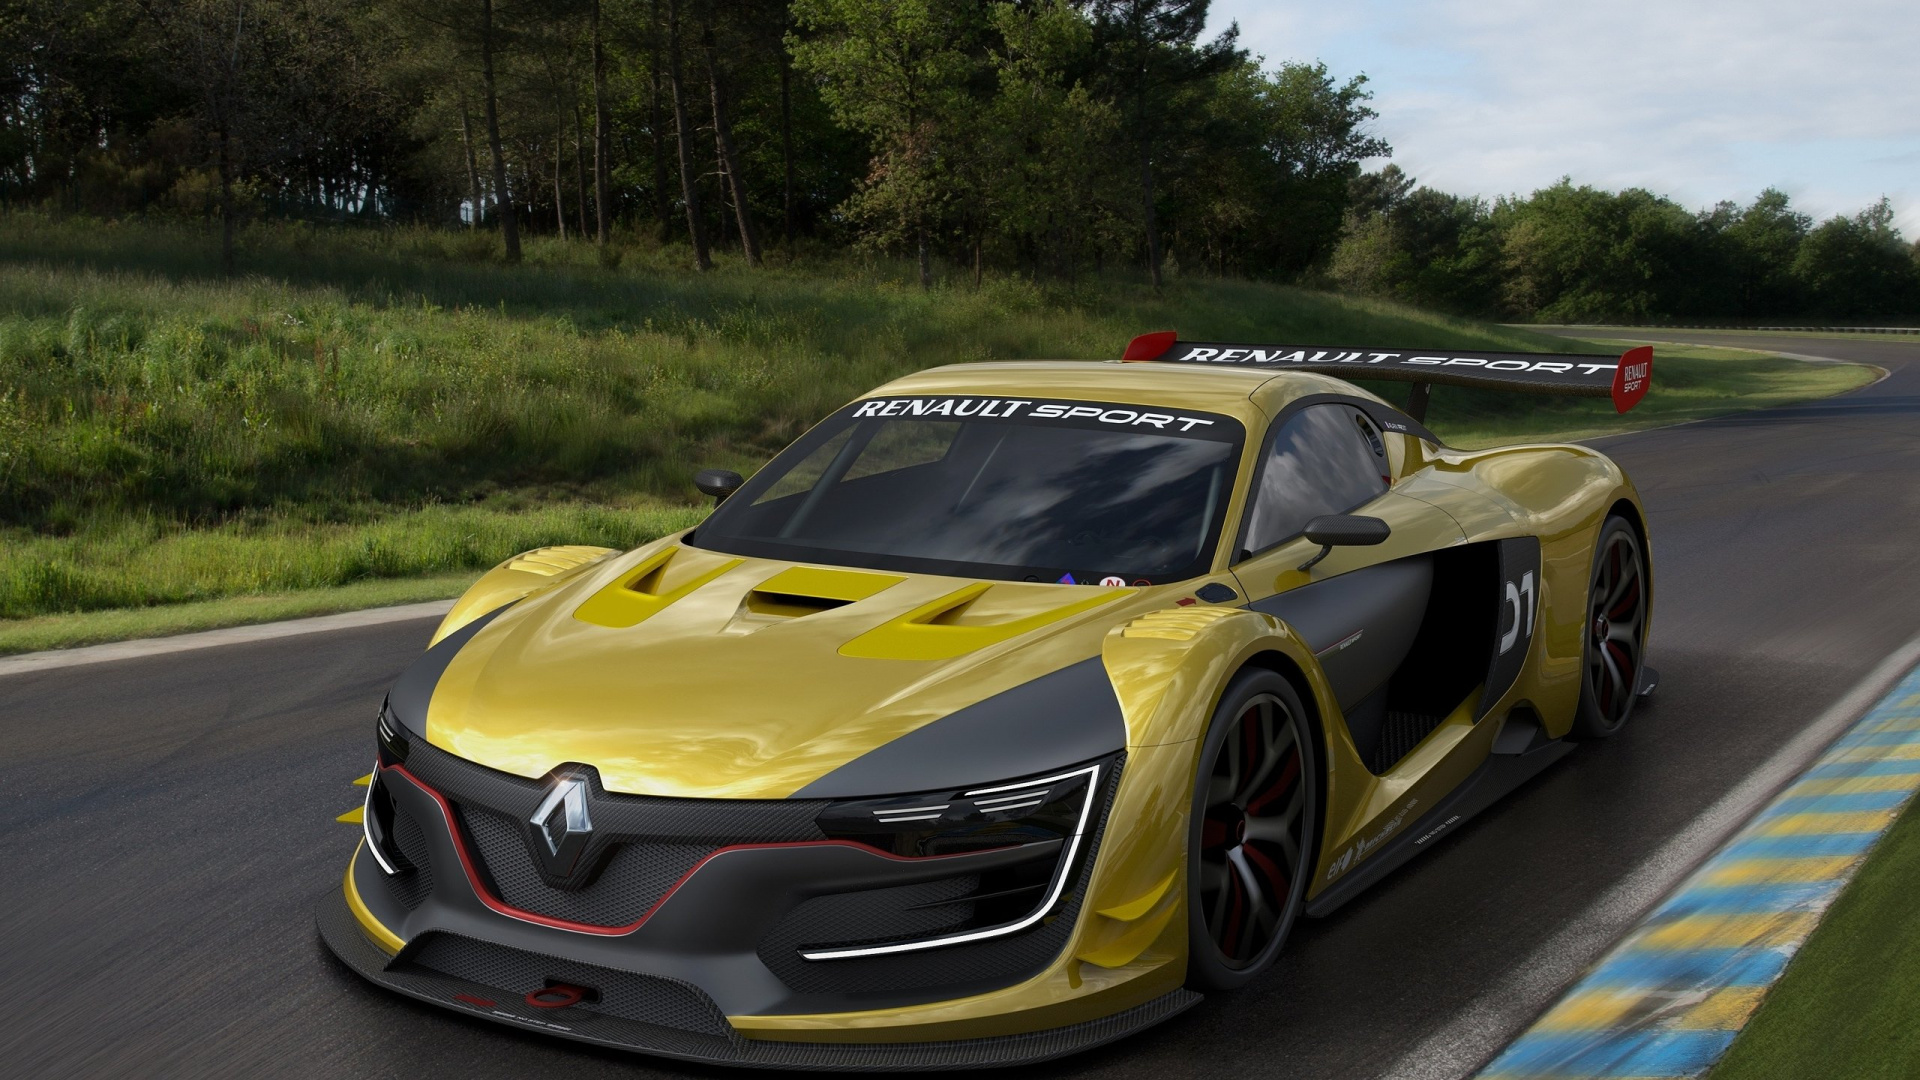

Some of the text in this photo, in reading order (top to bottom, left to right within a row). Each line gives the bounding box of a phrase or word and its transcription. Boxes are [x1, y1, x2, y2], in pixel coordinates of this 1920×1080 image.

[1179, 347, 1619, 375] RENAULT SPORT
[1624, 362, 1648, 382] RENAULT
[1624, 379, 1642, 393] SPORT
[852, 399, 1215, 432] RENAULT SPORT
